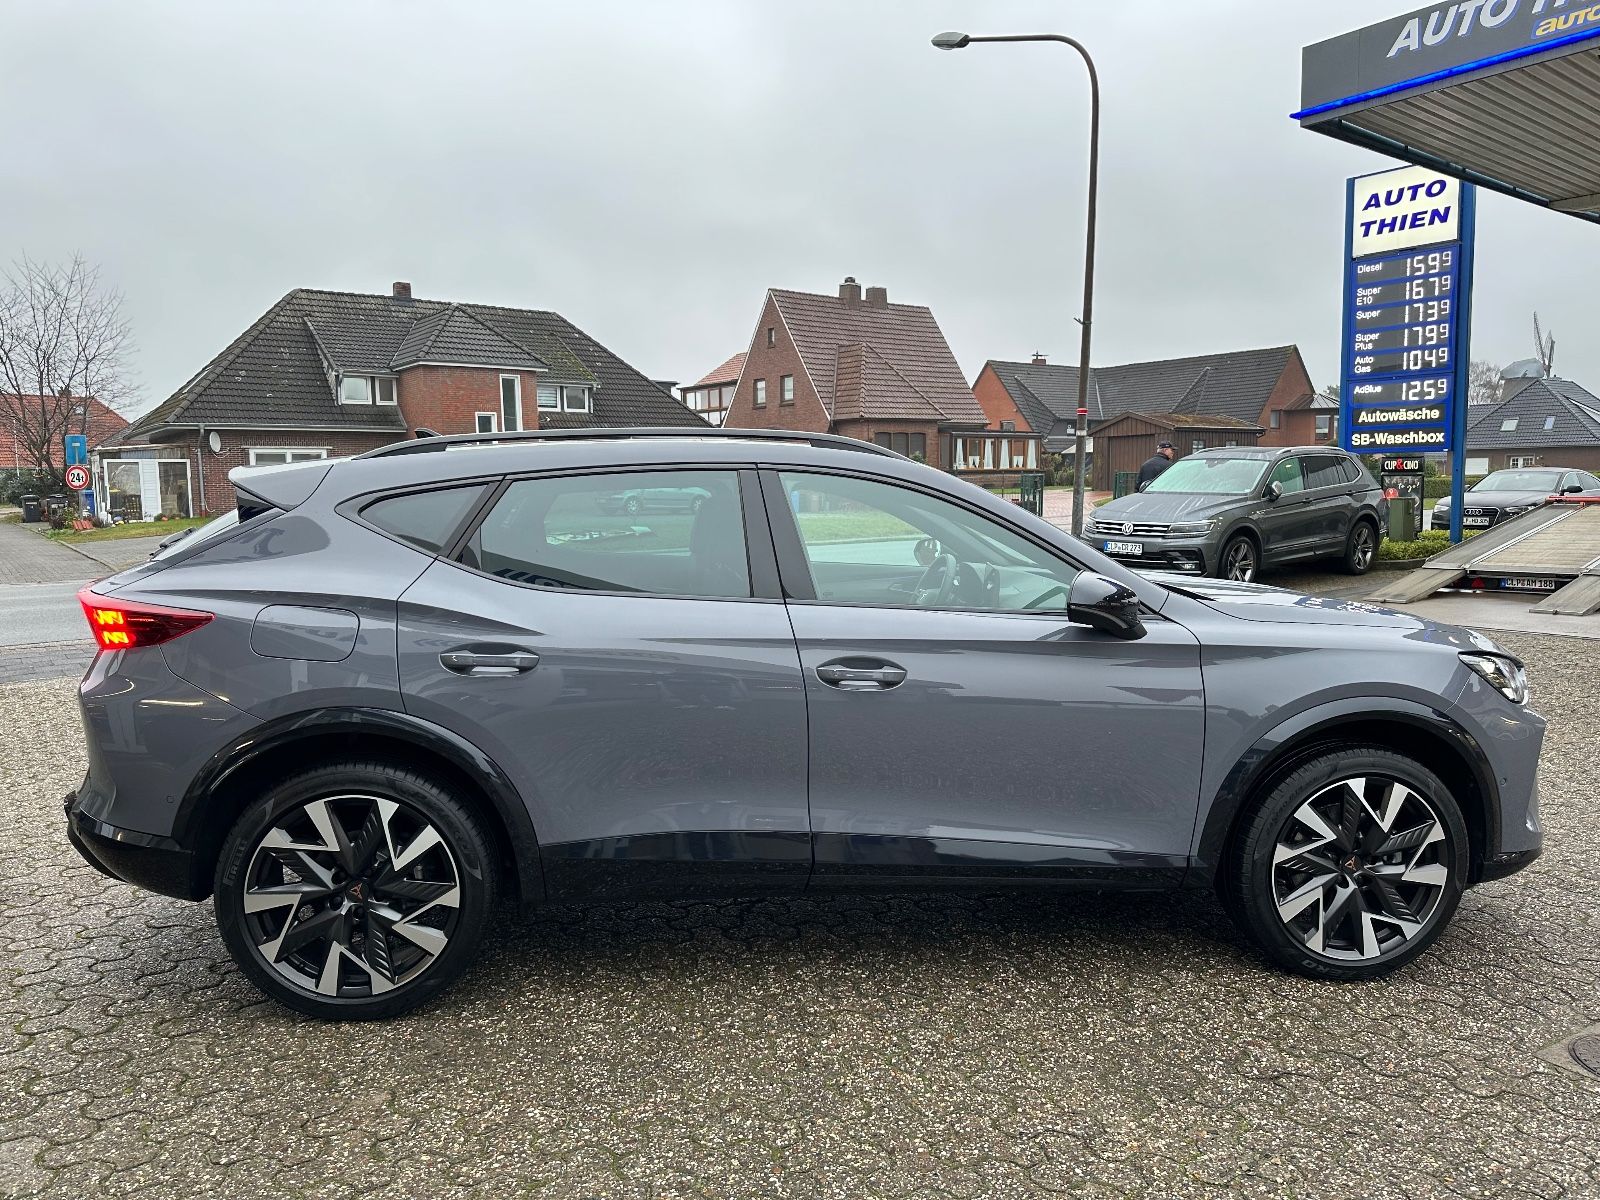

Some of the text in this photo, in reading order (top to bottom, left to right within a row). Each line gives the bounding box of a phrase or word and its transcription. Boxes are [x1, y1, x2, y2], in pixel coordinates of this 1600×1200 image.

[1362, 179, 1447, 211] AUTO
[1360, 206, 1451, 237] THIEN
[1357, 251, 1451, 276] Diesel 1599
[1356, 275, 1451, 300] Super 1679
[1356, 297, 1373, 306] E10
[1356, 299, 1450, 324] Super 1739
[1354, 342, 1373, 351] Plus
[1355, 323, 1449, 347] Super 1799
[1354, 347, 1448, 371] Auto 1049
[1354, 364, 1372, 374] Gas
[1354, 378, 1447, 401] AdBlue 1259
[1358, 407, 1440, 423] Autowäsche
[1351, 431, 1445, 446] SB-Waschbox
